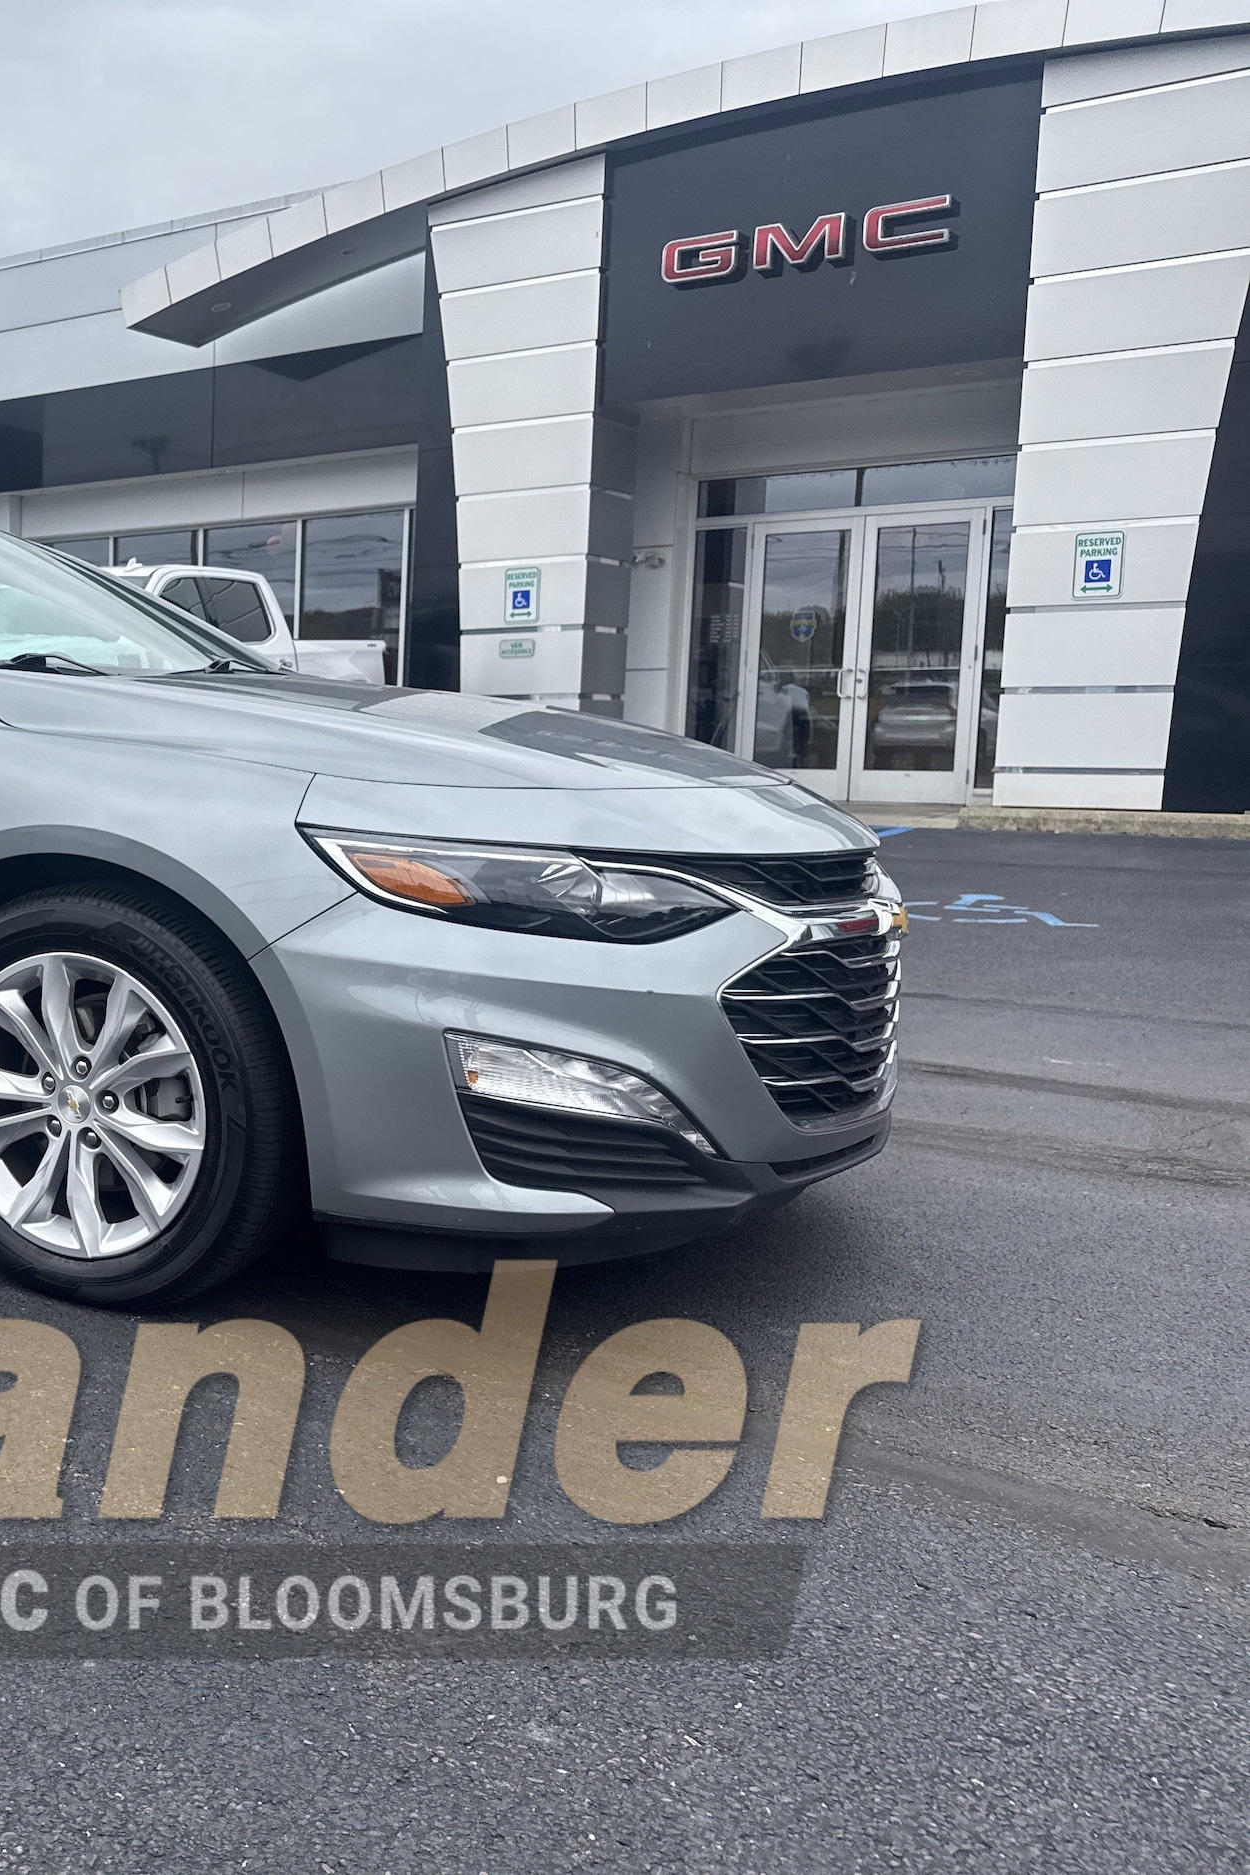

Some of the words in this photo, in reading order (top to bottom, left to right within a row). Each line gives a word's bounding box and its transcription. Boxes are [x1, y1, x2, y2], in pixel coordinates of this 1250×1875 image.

[661, 194, 951, 283] GMC
[1078, 536, 1121, 547] RESERVED
[1080, 547, 1117, 557] PARKING
[507, 571, 536, 580] RESERVED
[509, 580, 535, 589] PARKING
[511, 641, 523, 649] VAN
